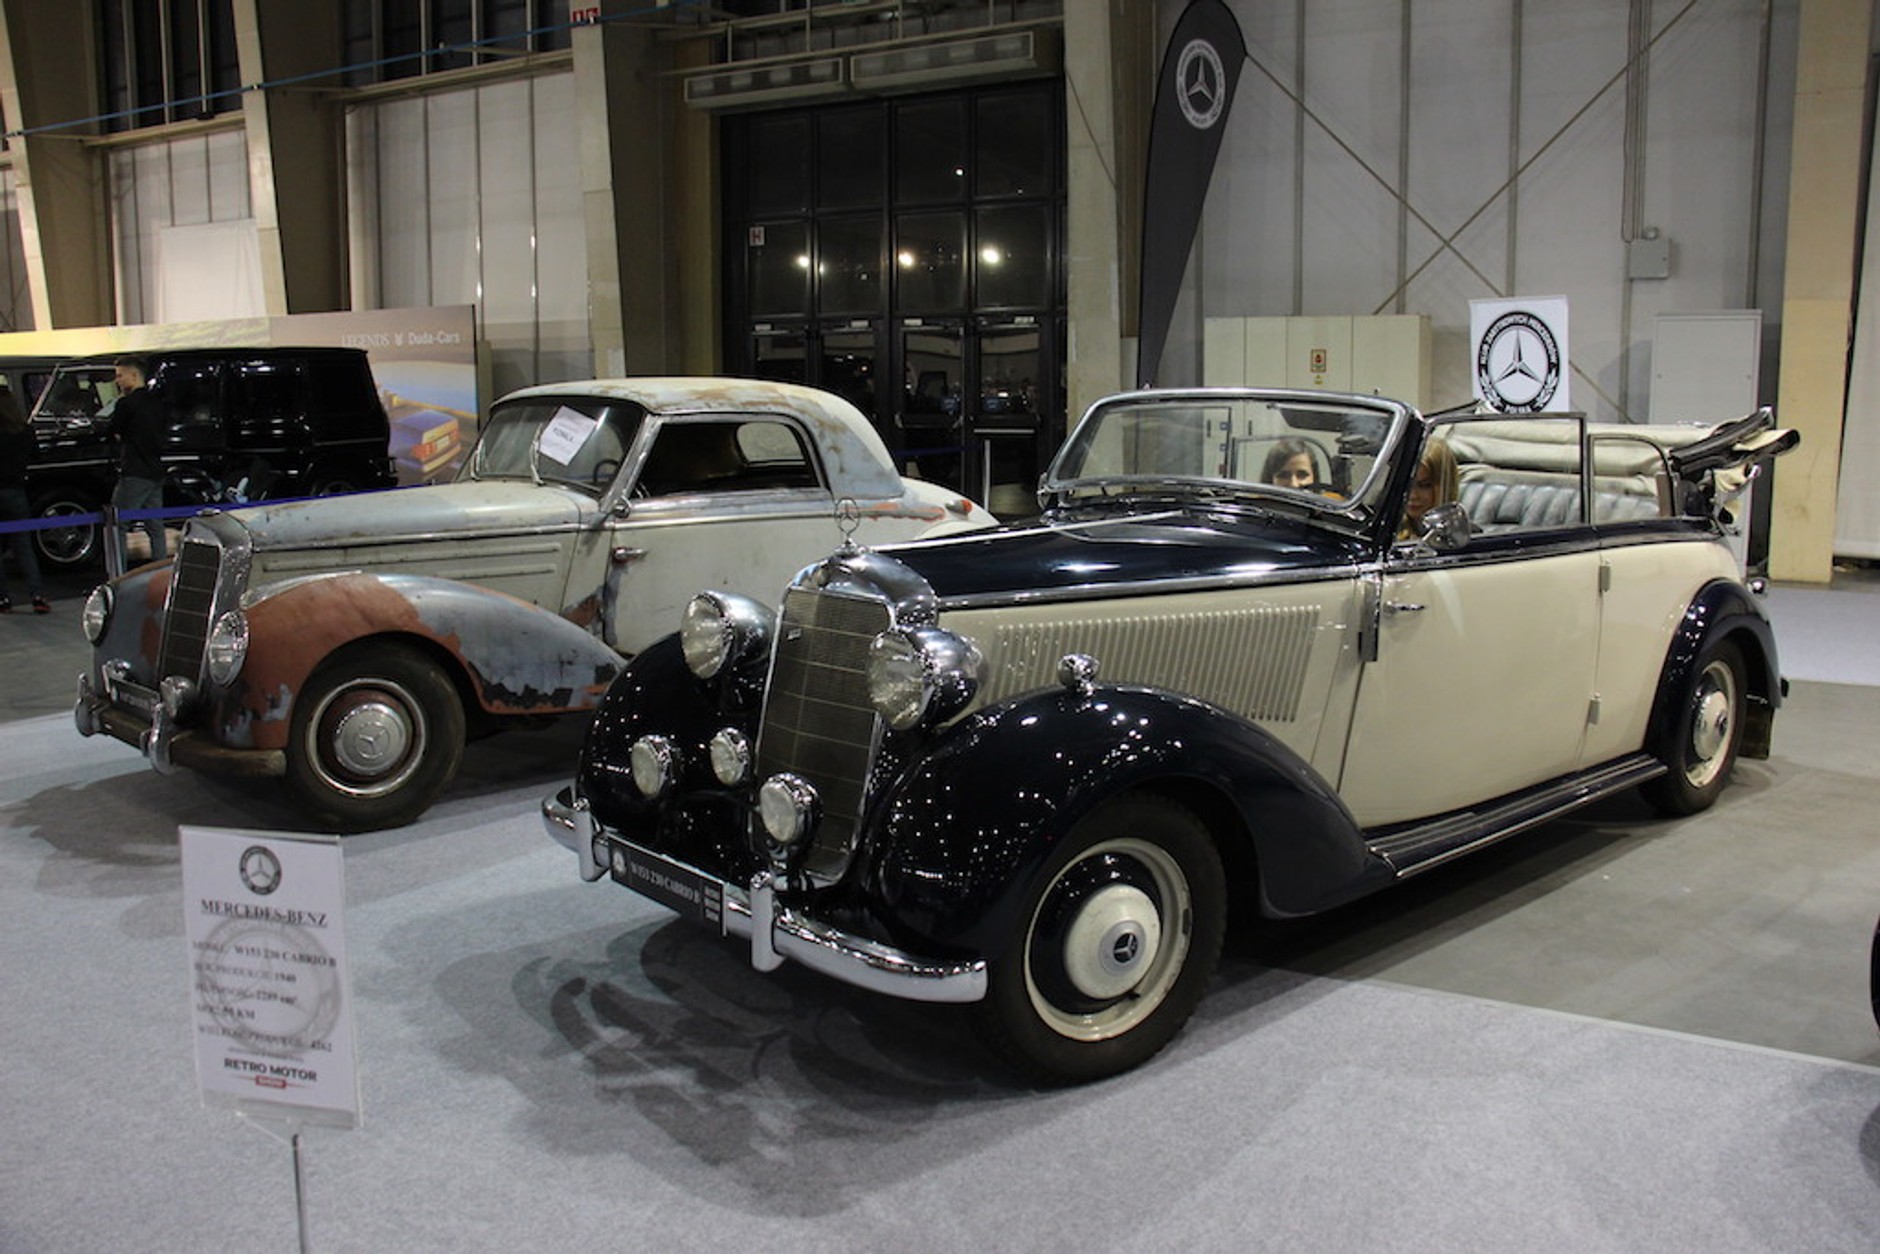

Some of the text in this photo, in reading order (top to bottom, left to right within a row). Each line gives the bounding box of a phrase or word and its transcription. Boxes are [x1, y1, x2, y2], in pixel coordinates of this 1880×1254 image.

[340, 330, 460, 347] LEGENDS Duda-Cars
[200, 899, 328, 927] MERCEDES-BENZ
[282, 951, 327, 966] CABRIO
[223, 1057, 318, 1081] RETRO MOTOR
